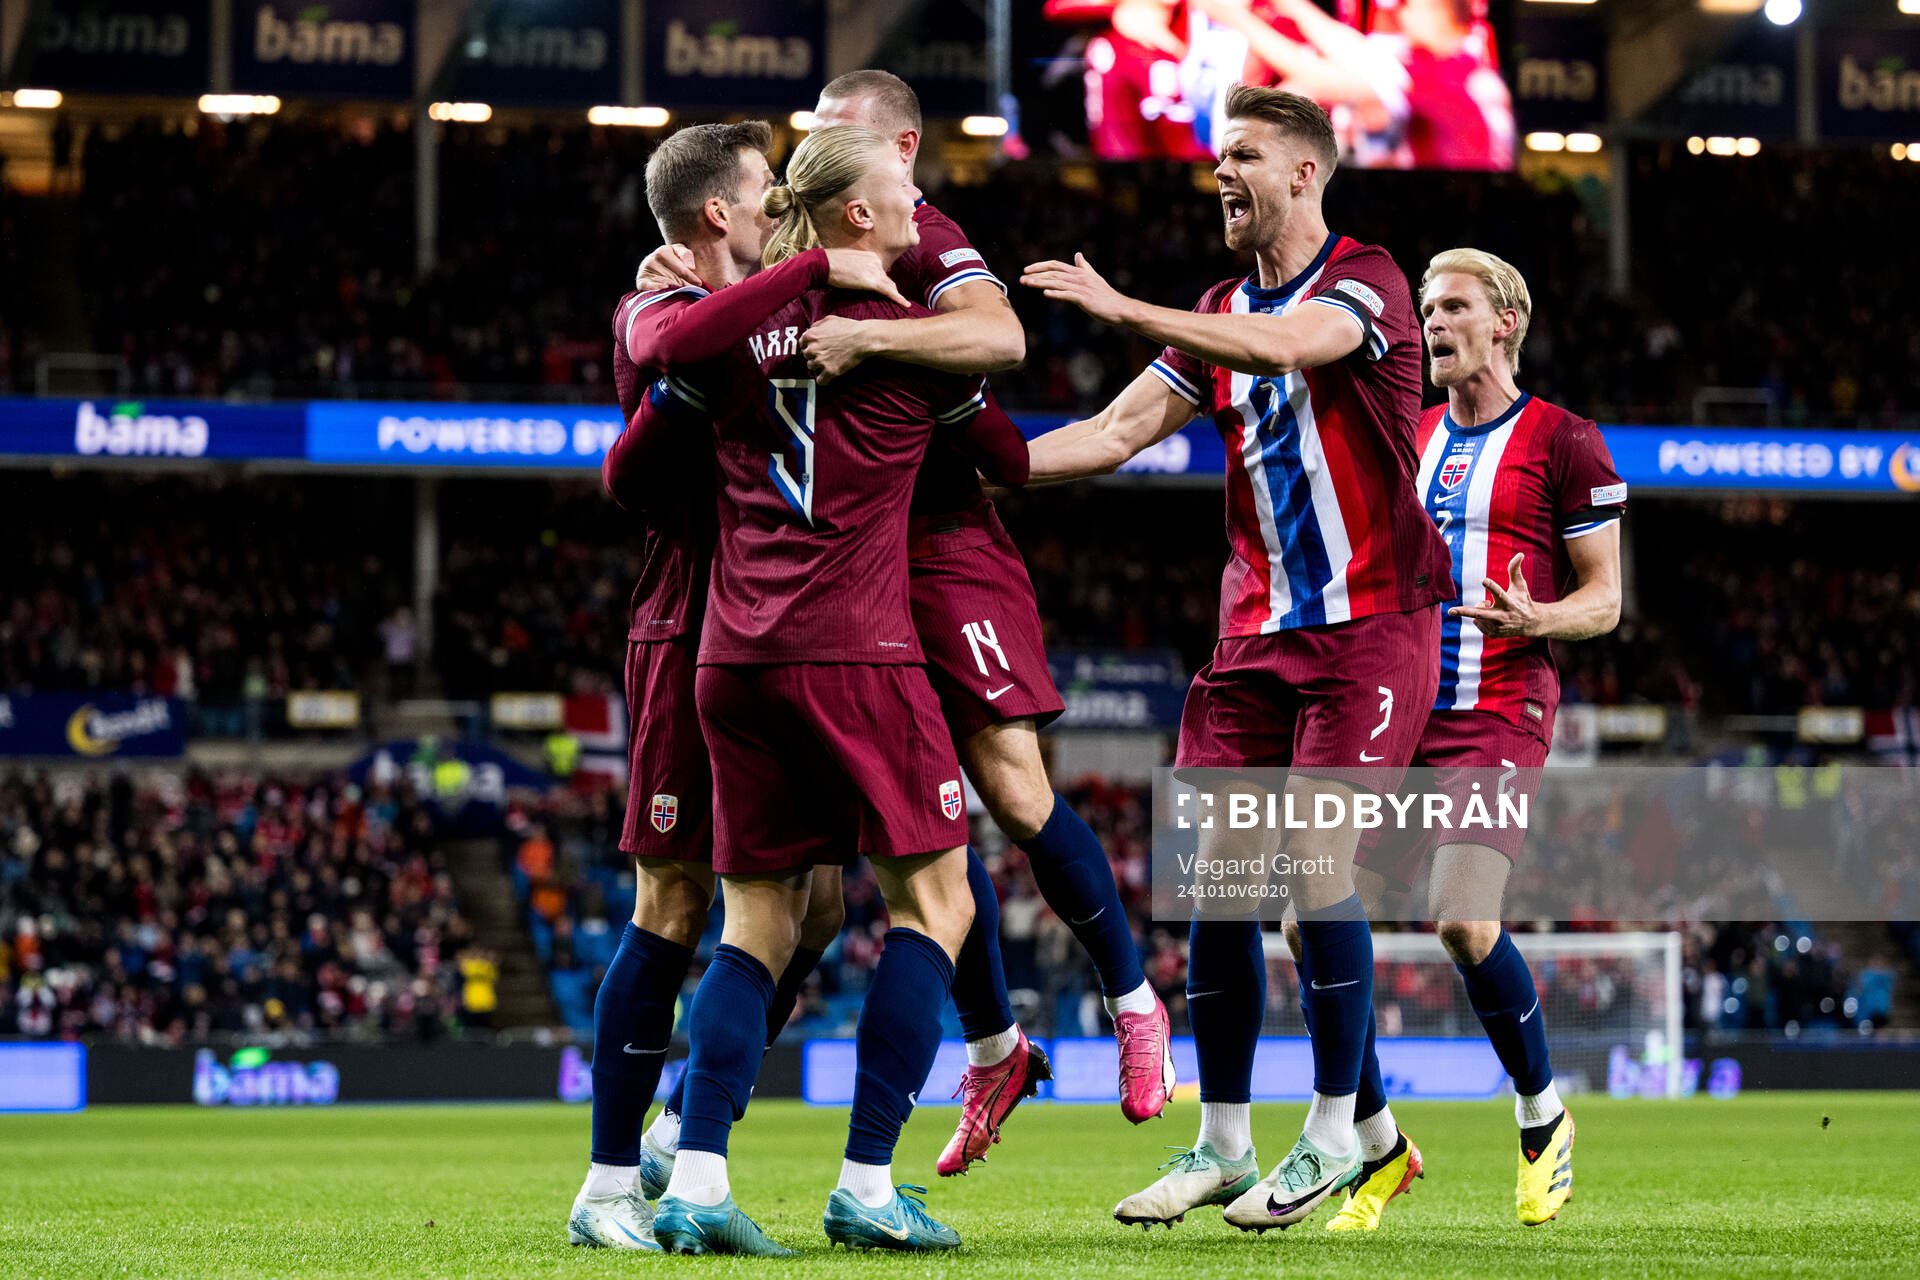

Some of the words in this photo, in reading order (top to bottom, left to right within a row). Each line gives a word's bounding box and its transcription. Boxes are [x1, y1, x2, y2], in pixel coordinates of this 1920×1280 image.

[254, 4, 404, 67] bama
[489, 27, 609, 70] ama
[664, 19, 813, 80] bama
[1516, 58, 1599, 101] ma
[749, 326, 799, 364] HAA
[75, 401, 210, 457] bama
[378, 416, 567, 455] POWERED
[572, 419, 622, 456] BY
[768, 379, 816, 528] 9
[1658, 440, 1834, 479] POWERED
[1838, 443, 1884, 479] BY
[961, 619, 1011, 677] 14
[1370, 685, 1394, 741] 3
[193, 1048, 339, 1105] bama
